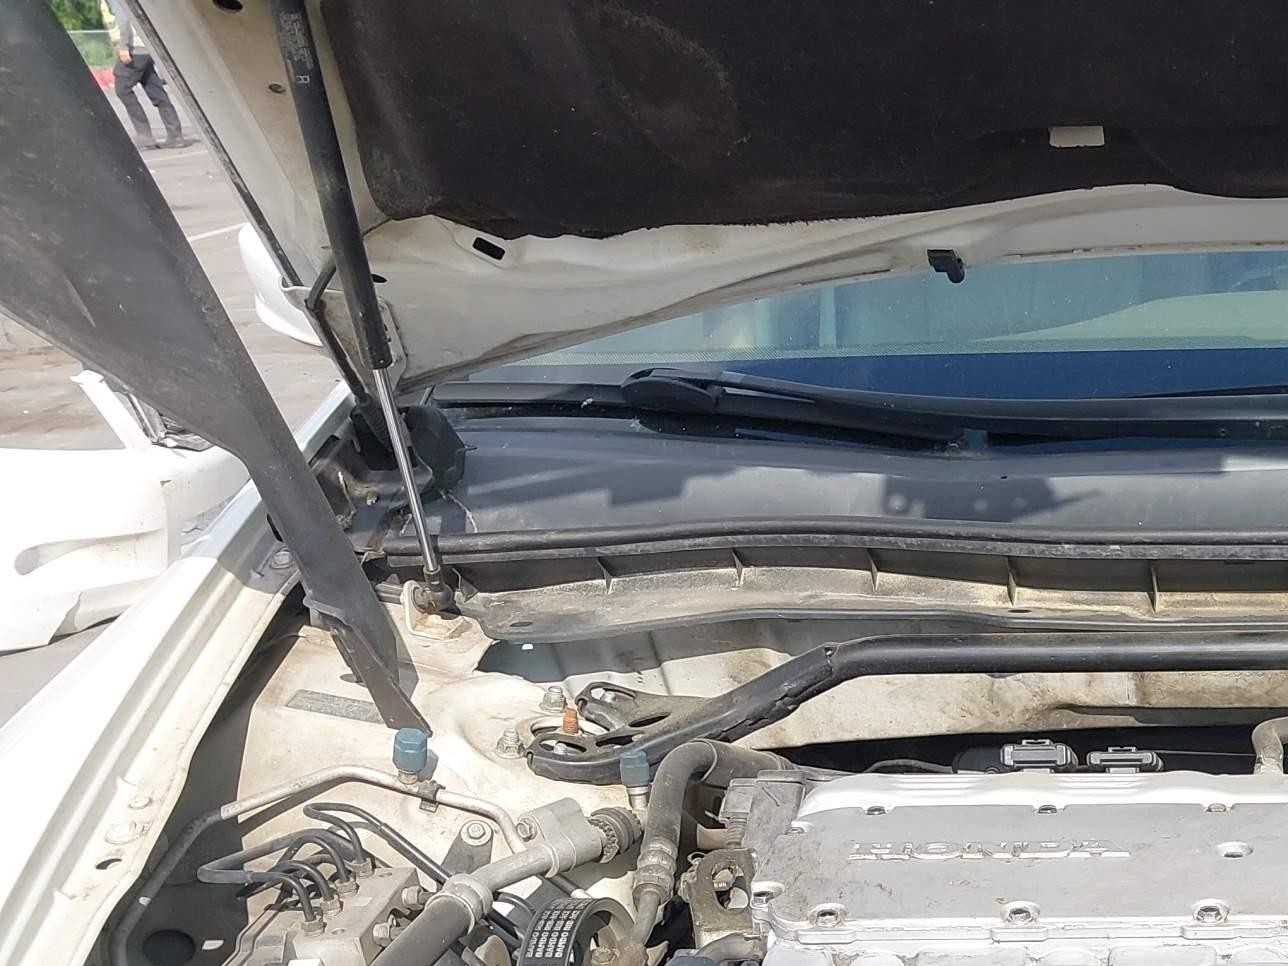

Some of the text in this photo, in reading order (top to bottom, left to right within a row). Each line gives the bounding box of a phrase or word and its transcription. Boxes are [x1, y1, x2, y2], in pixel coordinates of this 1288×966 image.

[848, 839, 1132, 861] HONDA
[526, 932, 540, 958] BANDO
[535, 932, 550, 958] BANDO
[545, 932, 558, 958] BANDO
[554, 932, 568, 958] BANDO
